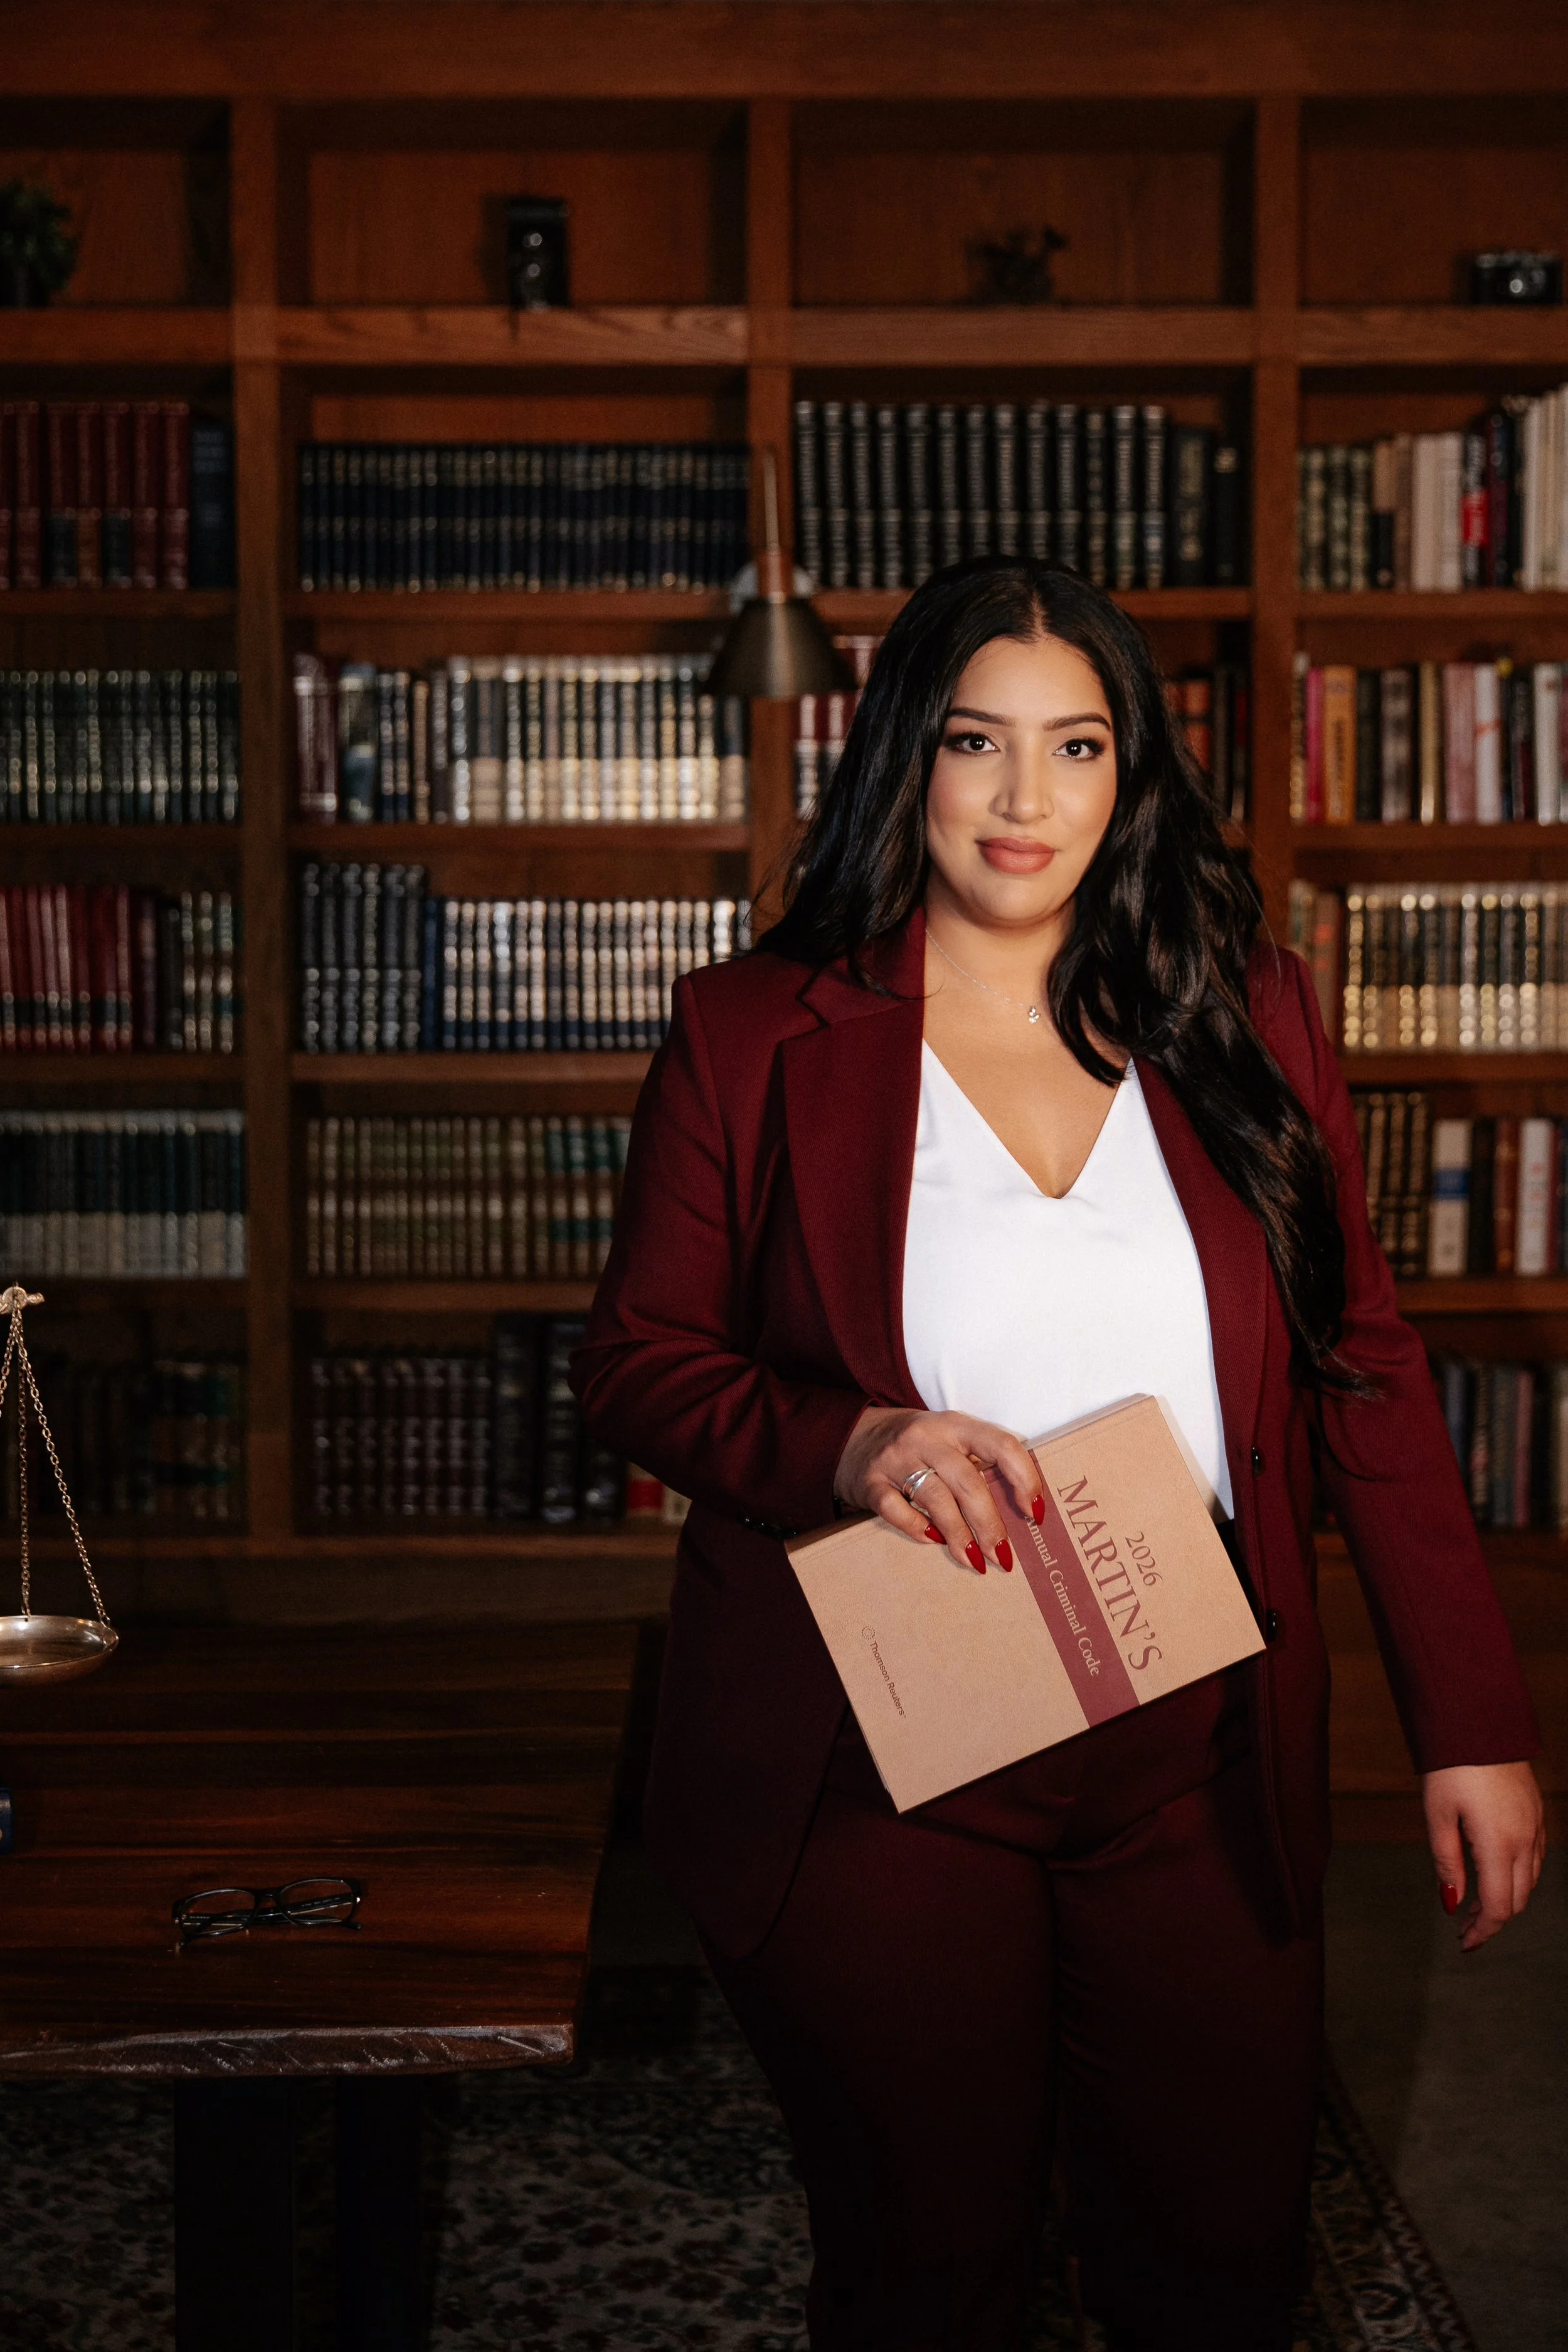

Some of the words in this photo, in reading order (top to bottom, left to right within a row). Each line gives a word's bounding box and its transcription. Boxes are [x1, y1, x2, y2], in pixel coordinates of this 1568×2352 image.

[1125, 1531, 1163, 1586] 2026
[1049, 1570, 1086, 1636] Criminal
[1078, 1637, 1101, 1676] Code
[870, 1640, 890, 1682] Thomson
